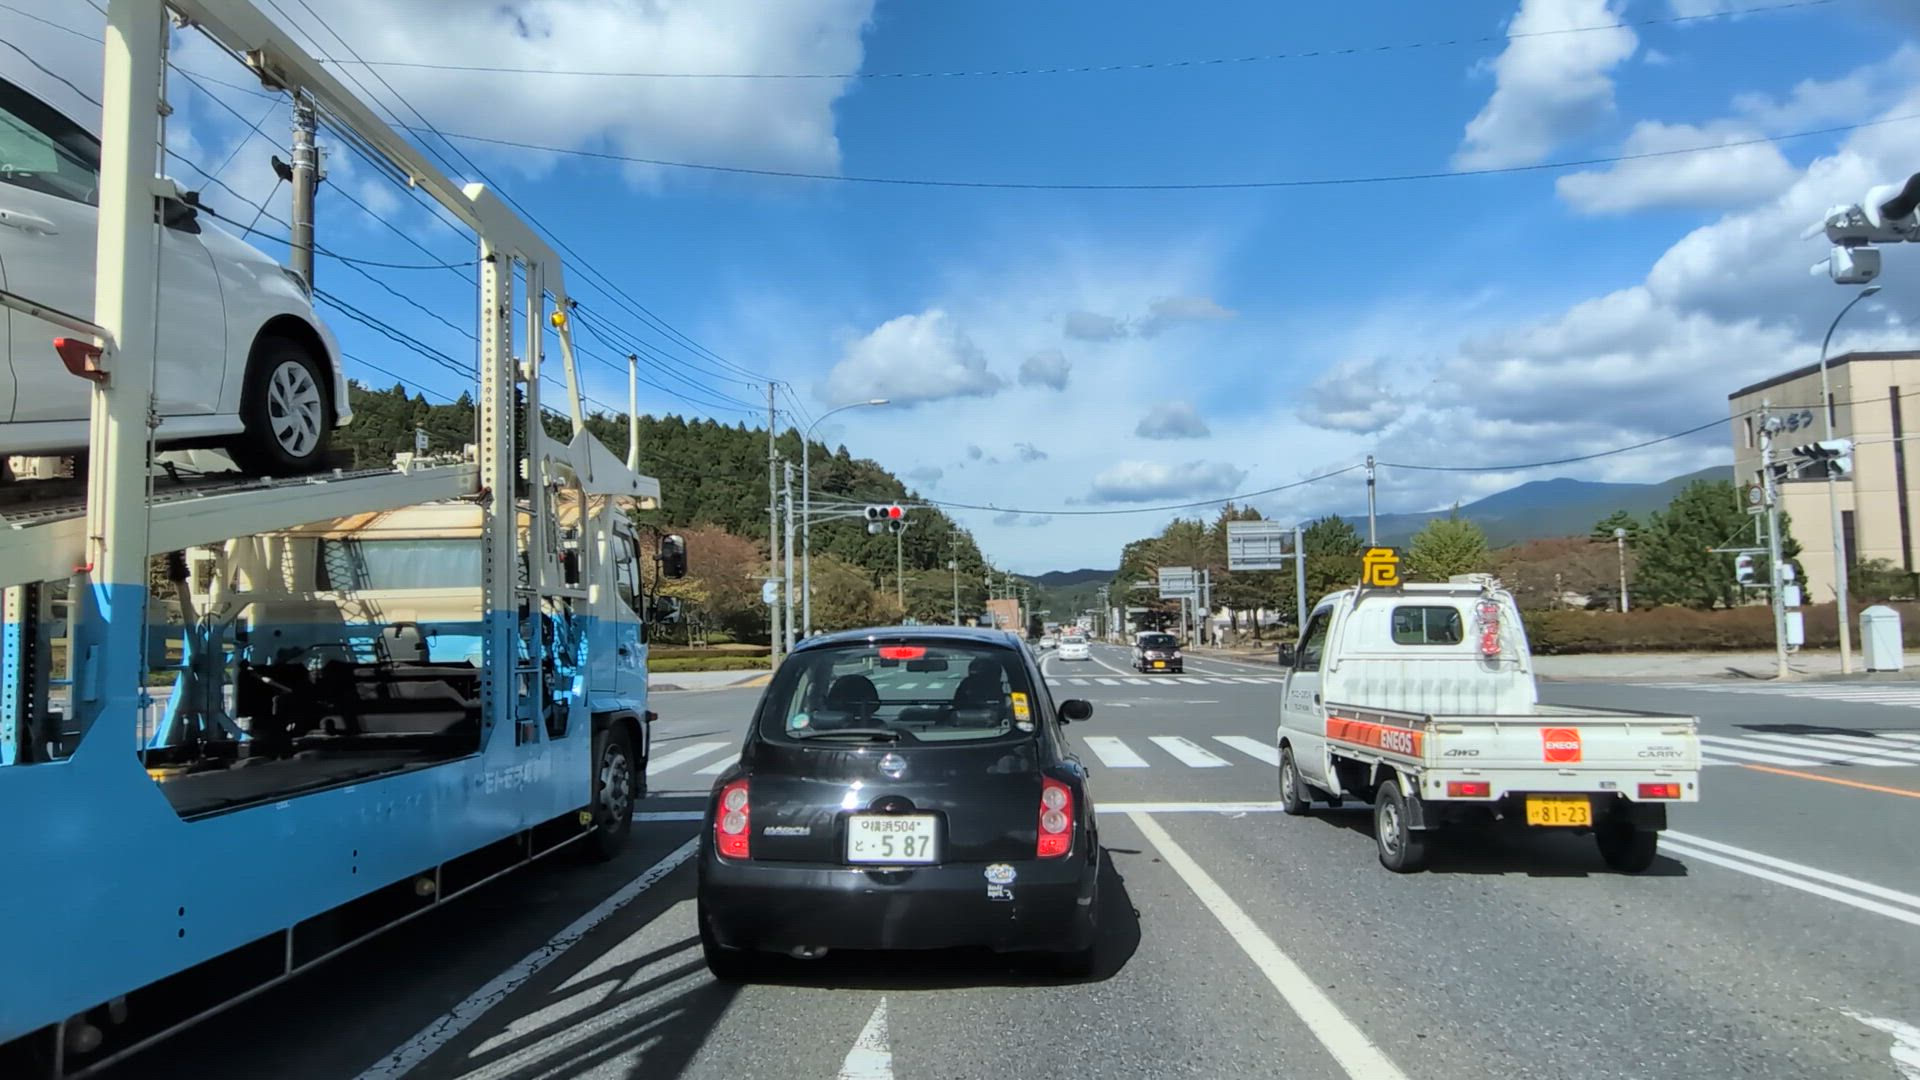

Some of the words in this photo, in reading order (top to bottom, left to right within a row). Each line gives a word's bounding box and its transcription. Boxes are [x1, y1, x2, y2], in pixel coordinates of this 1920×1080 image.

[1362, 548, 1399, 586] 危
[1380, 728, 1412, 753] ENEOS
[1545, 741, 1579, 750] ENEOS
[1443, 749, 1480, 757] 4WD
[1541, 806, 1587, 823] 81-23
